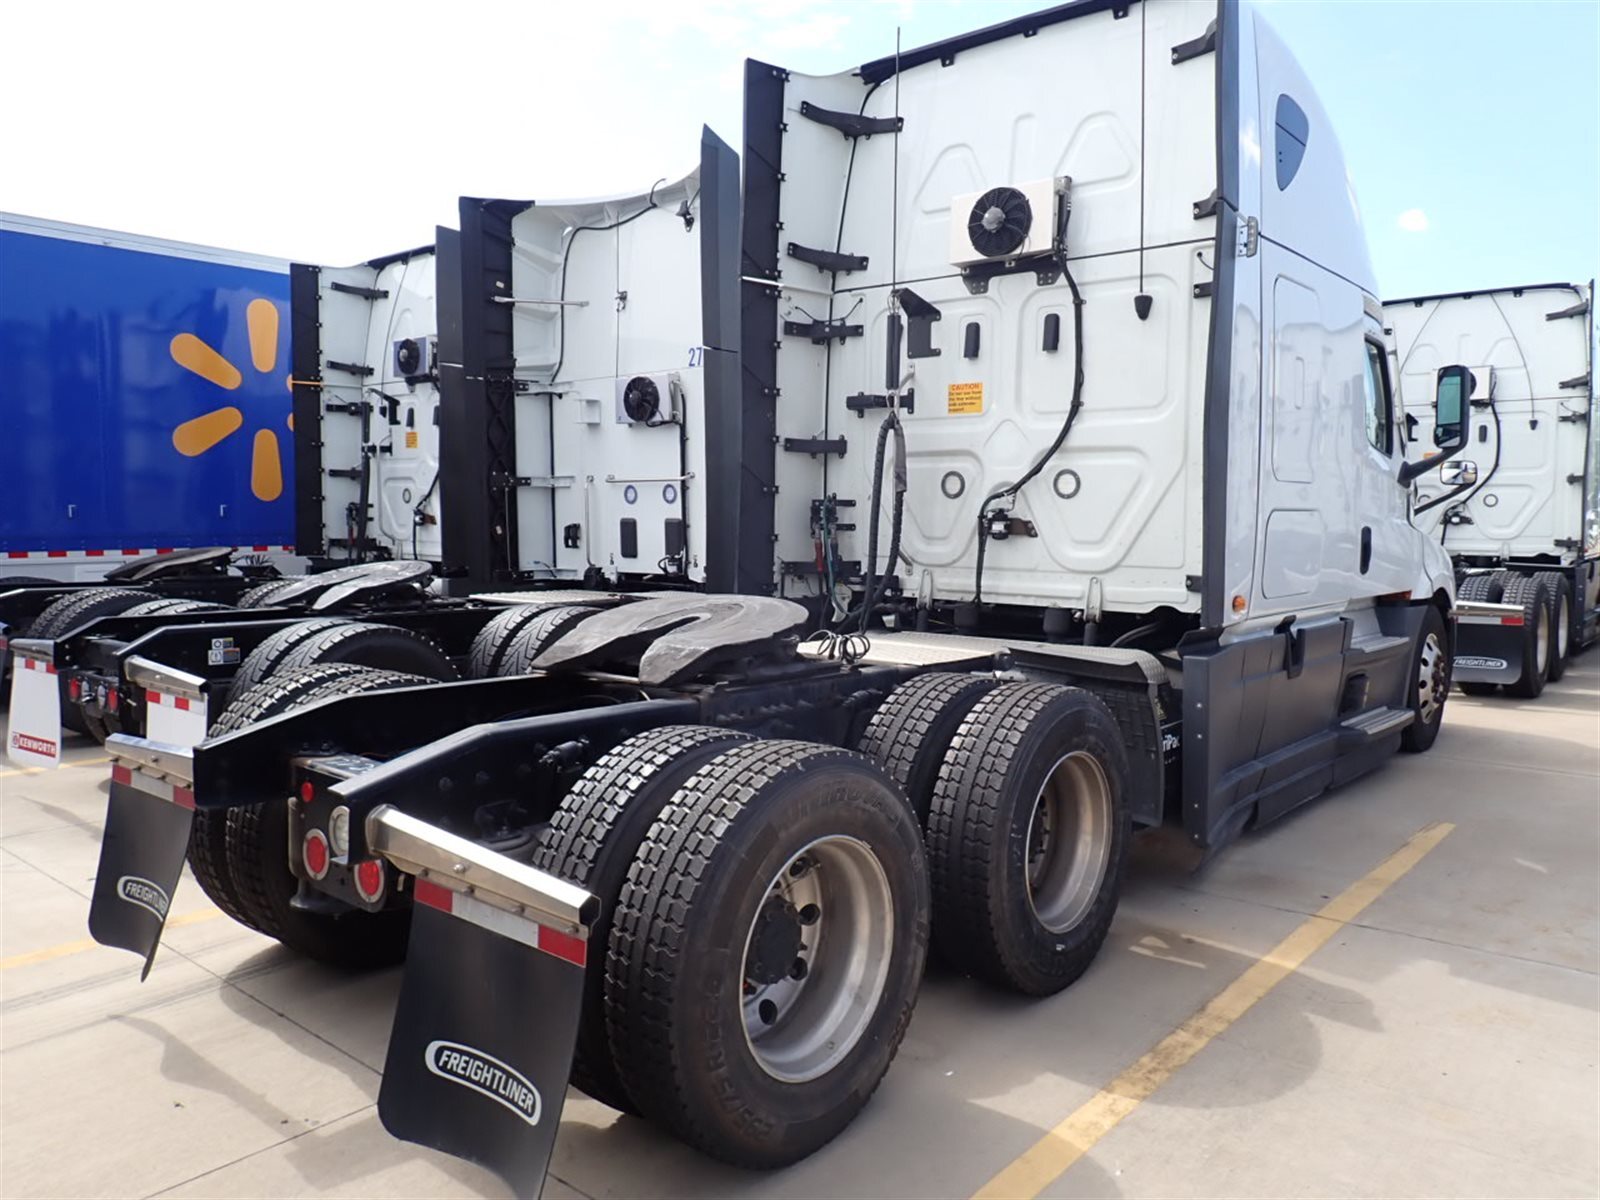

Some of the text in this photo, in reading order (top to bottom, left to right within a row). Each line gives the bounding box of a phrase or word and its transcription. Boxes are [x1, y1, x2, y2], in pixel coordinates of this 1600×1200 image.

[688, 347, 702, 367] 27
[18, 736, 56, 757] KENWORTH
[438, 1049, 534, 1113] FREIGHTLINER
